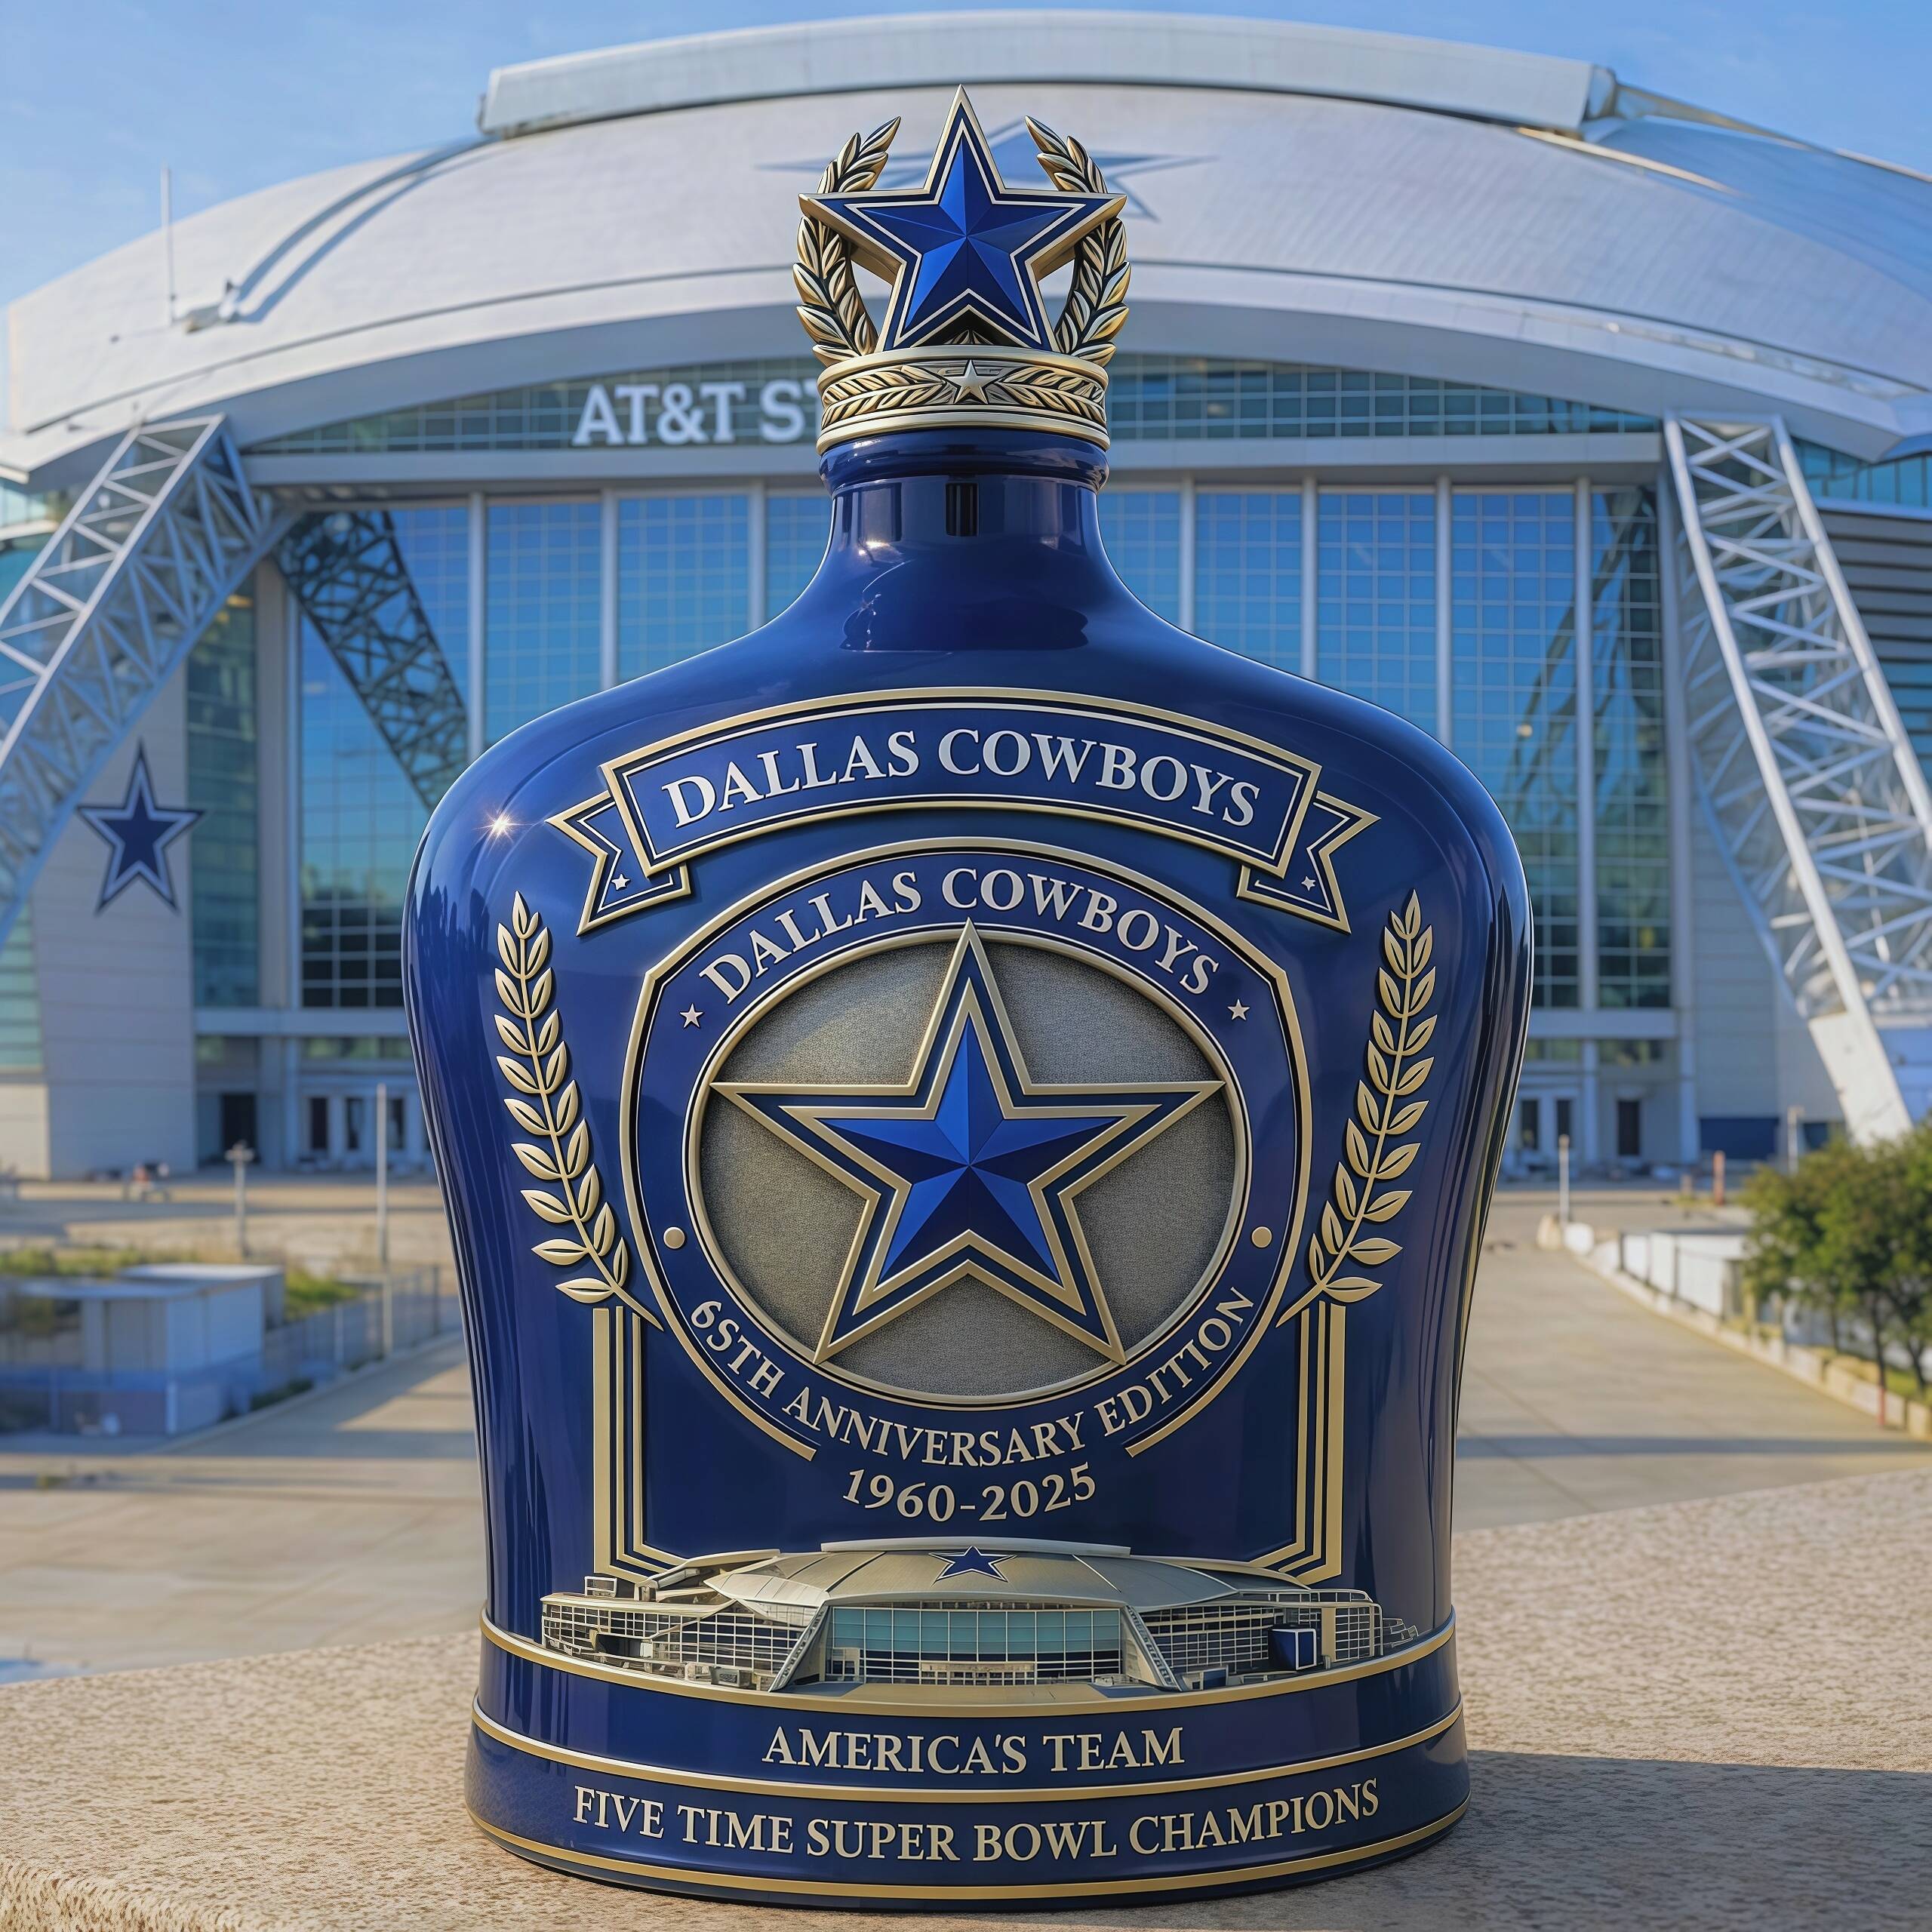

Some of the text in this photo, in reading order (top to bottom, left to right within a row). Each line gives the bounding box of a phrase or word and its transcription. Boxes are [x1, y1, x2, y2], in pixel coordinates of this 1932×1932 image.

[572, 383, 746, 446] AT&T
[661, 728, 1260, 829] DALLAS COWBOYS
[698, 868, 1219, 1005] DALLAS COWBOYS
[781, 1386, 1085, 1467] ANNIVERSARY
[1094, 1286, 1254, 1437] EDITION
[842, 1461, 1095, 1521] 1960-2025
[761, 1725, 1185, 1775] AMERICA'S TEAM
[573, 1777, 1379, 1862] FIVE TIME SUPER BOWL CHAMPIONS
